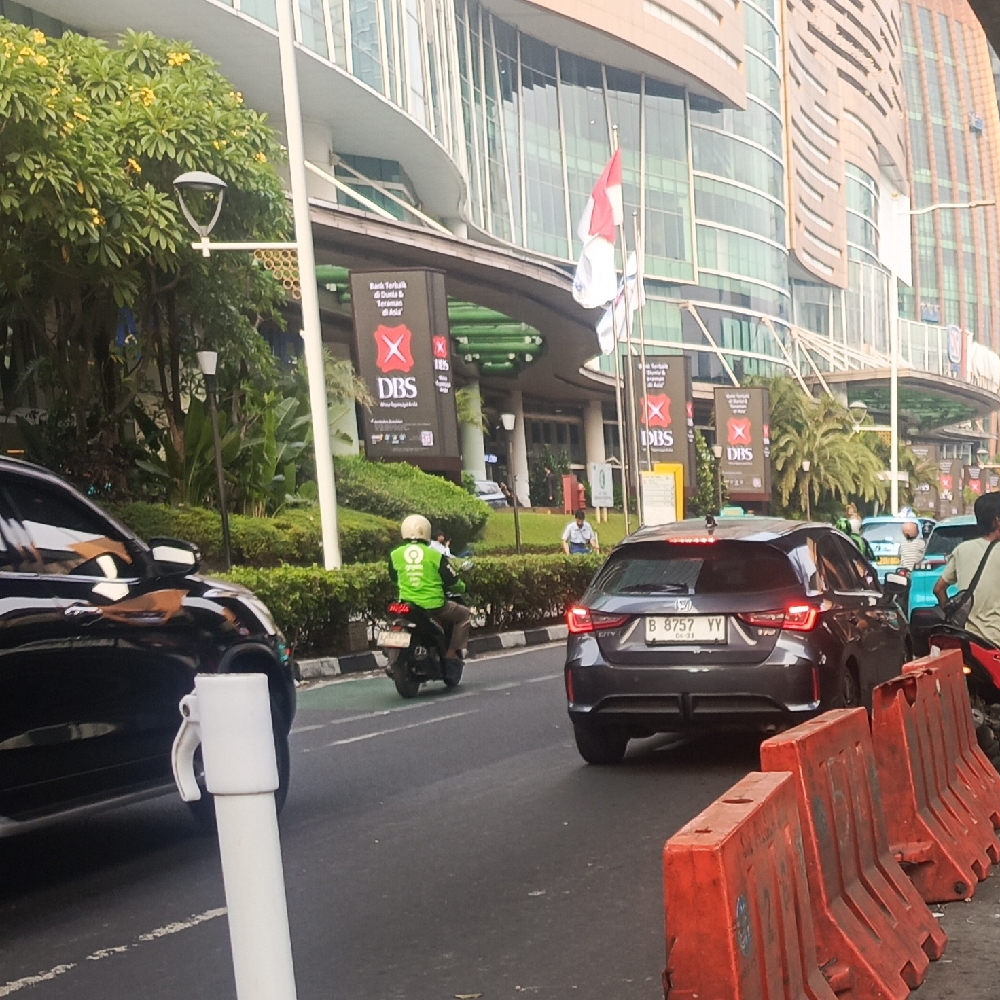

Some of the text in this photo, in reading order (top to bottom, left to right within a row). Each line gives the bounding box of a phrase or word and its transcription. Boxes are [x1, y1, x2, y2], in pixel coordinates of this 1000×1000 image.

[377, 376, 418, 399] DBS
[640, 430, 674, 447] DBS
[727, 447, 754, 461] DBS
[648, 618, 722, 632] B 8757 YY
